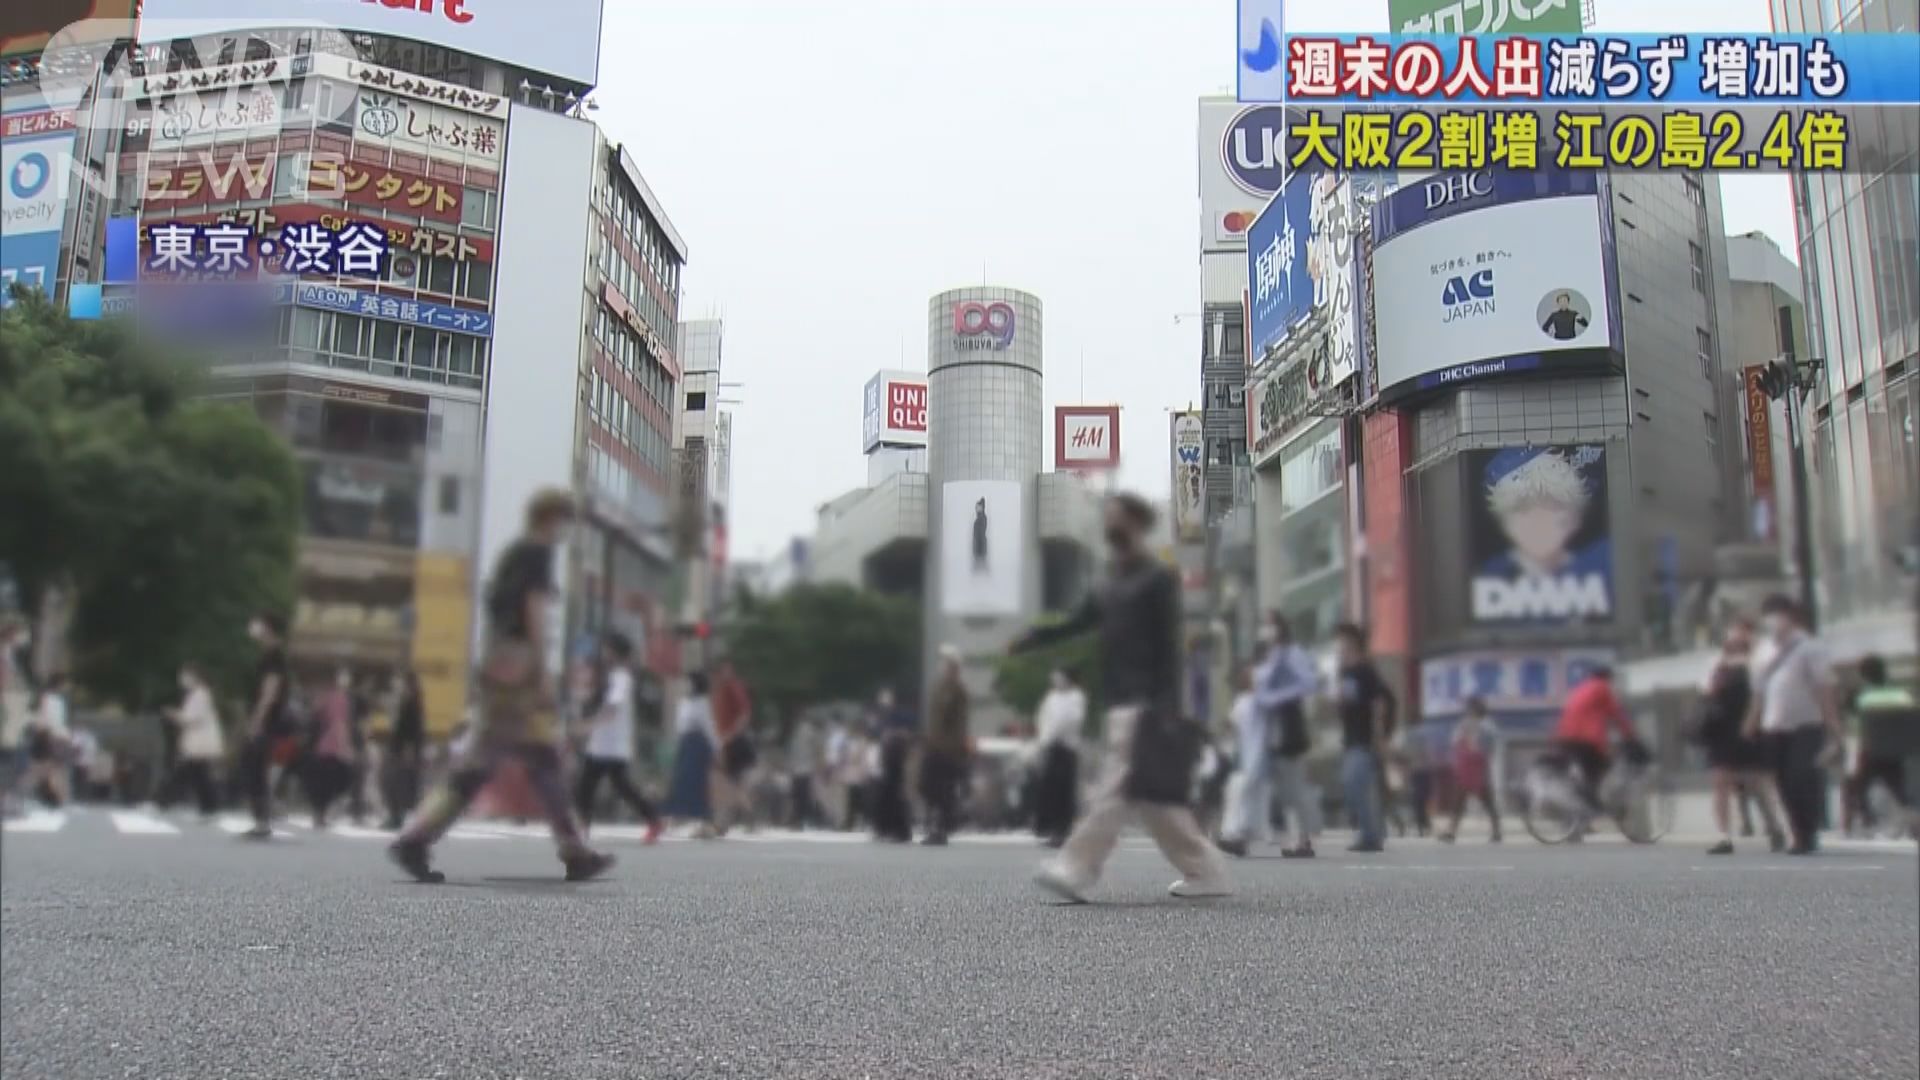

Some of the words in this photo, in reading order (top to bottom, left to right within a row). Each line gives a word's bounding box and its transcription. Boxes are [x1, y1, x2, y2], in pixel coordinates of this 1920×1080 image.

[347, 61, 500, 112] しゃぶしゃぶバイキング
[127, 118, 151, 137] 9F
[407, 110, 497, 154] しゃぶ葉
[309, 160, 457, 212] コンタクト
[1425, 168, 1494, 209] DHC
[410, 228, 478, 262] ガスト
[304, 287, 351, 308] AEON
[1442, 269, 1494, 306] AC
[954, 302, 1015, 350] 109
[1442, 299, 1495, 323] JAPAN
[953, 338, 992, 350] SHIBUYA
[1440, 366, 1463, 382] DHC
[1463, 360, 1506, 377] Channel
